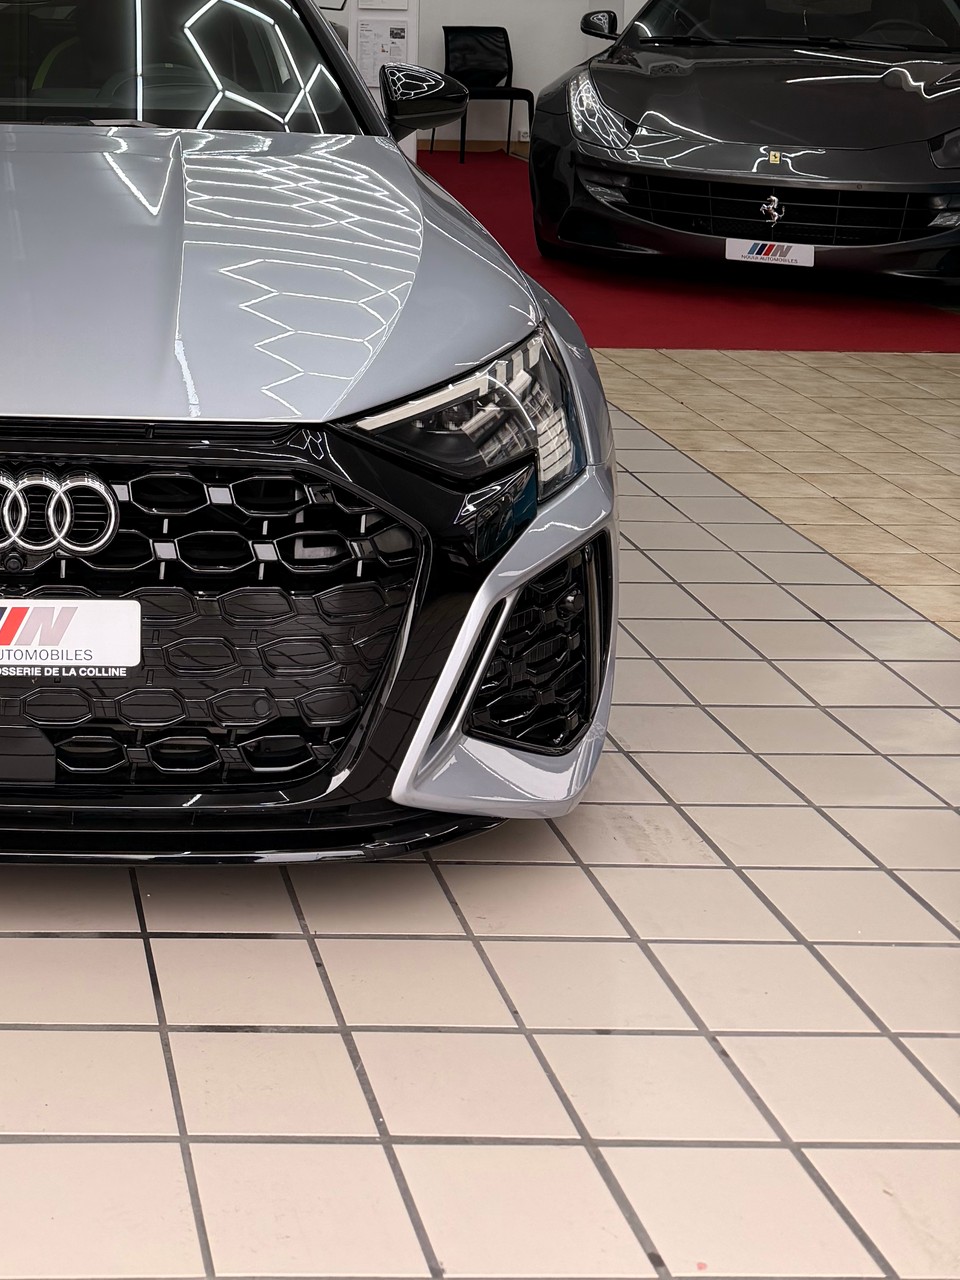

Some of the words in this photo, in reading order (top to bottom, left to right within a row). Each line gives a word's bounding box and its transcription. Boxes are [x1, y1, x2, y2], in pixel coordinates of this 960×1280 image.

[759, 256, 798, 264] AUTOMOBILES
[44, 667, 60, 677] DE
[62, 667, 76, 677] LA
[77, 667, 127, 677] COLLINE
